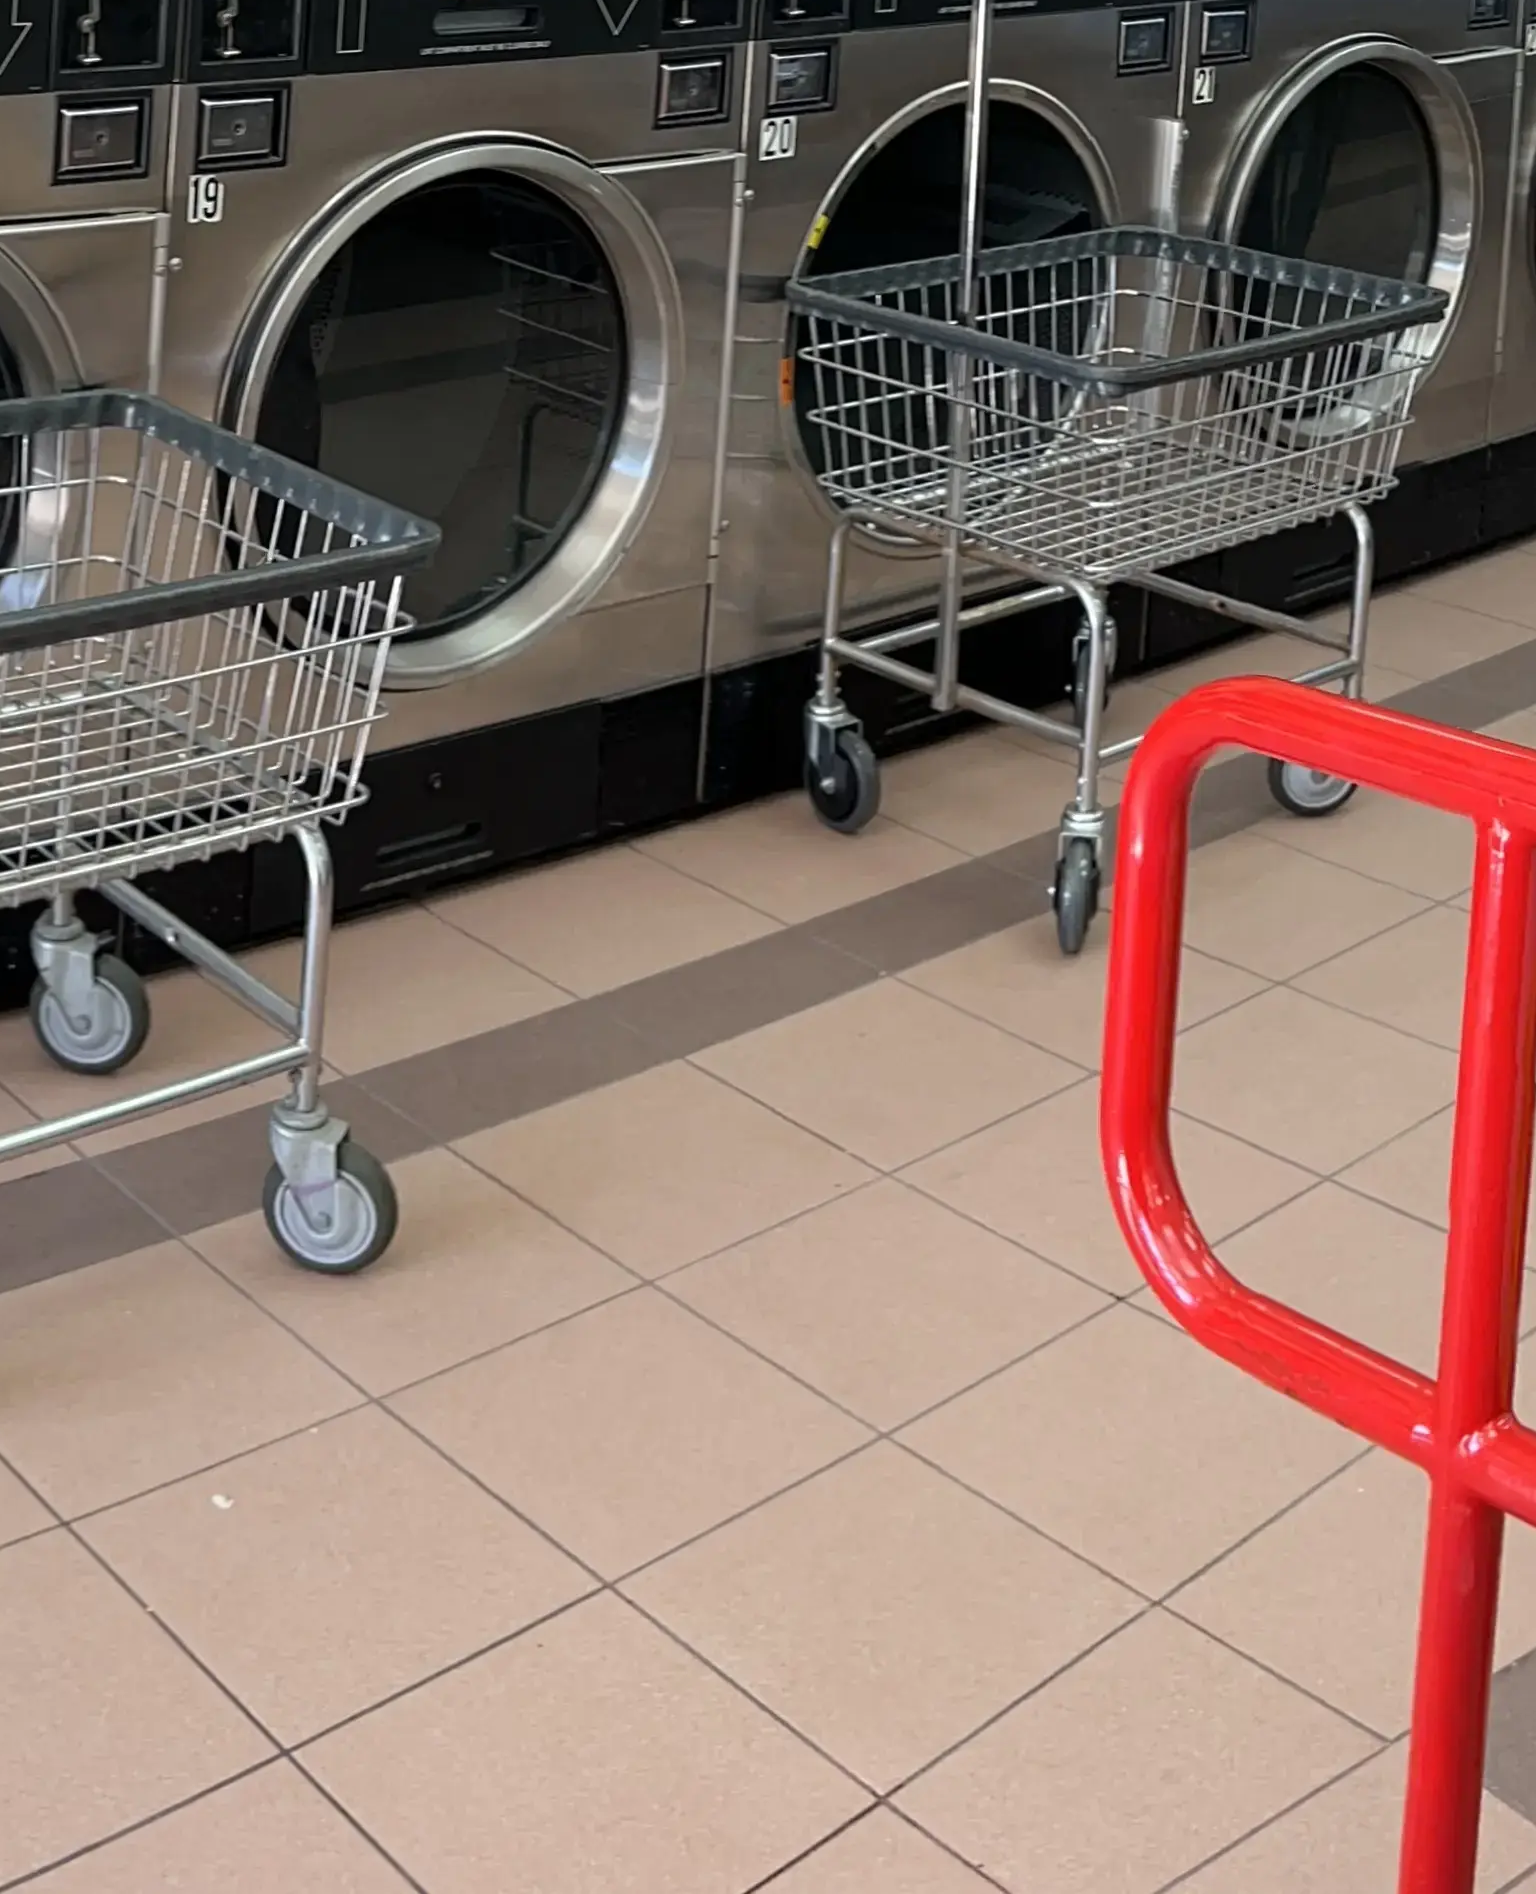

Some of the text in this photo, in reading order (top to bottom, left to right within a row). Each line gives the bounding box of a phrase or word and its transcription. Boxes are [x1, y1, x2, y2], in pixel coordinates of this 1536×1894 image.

[1195, 68, 1215, 102] 21
[763, 118, 792, 157] 20
[191, 176, 220, 219] 19
